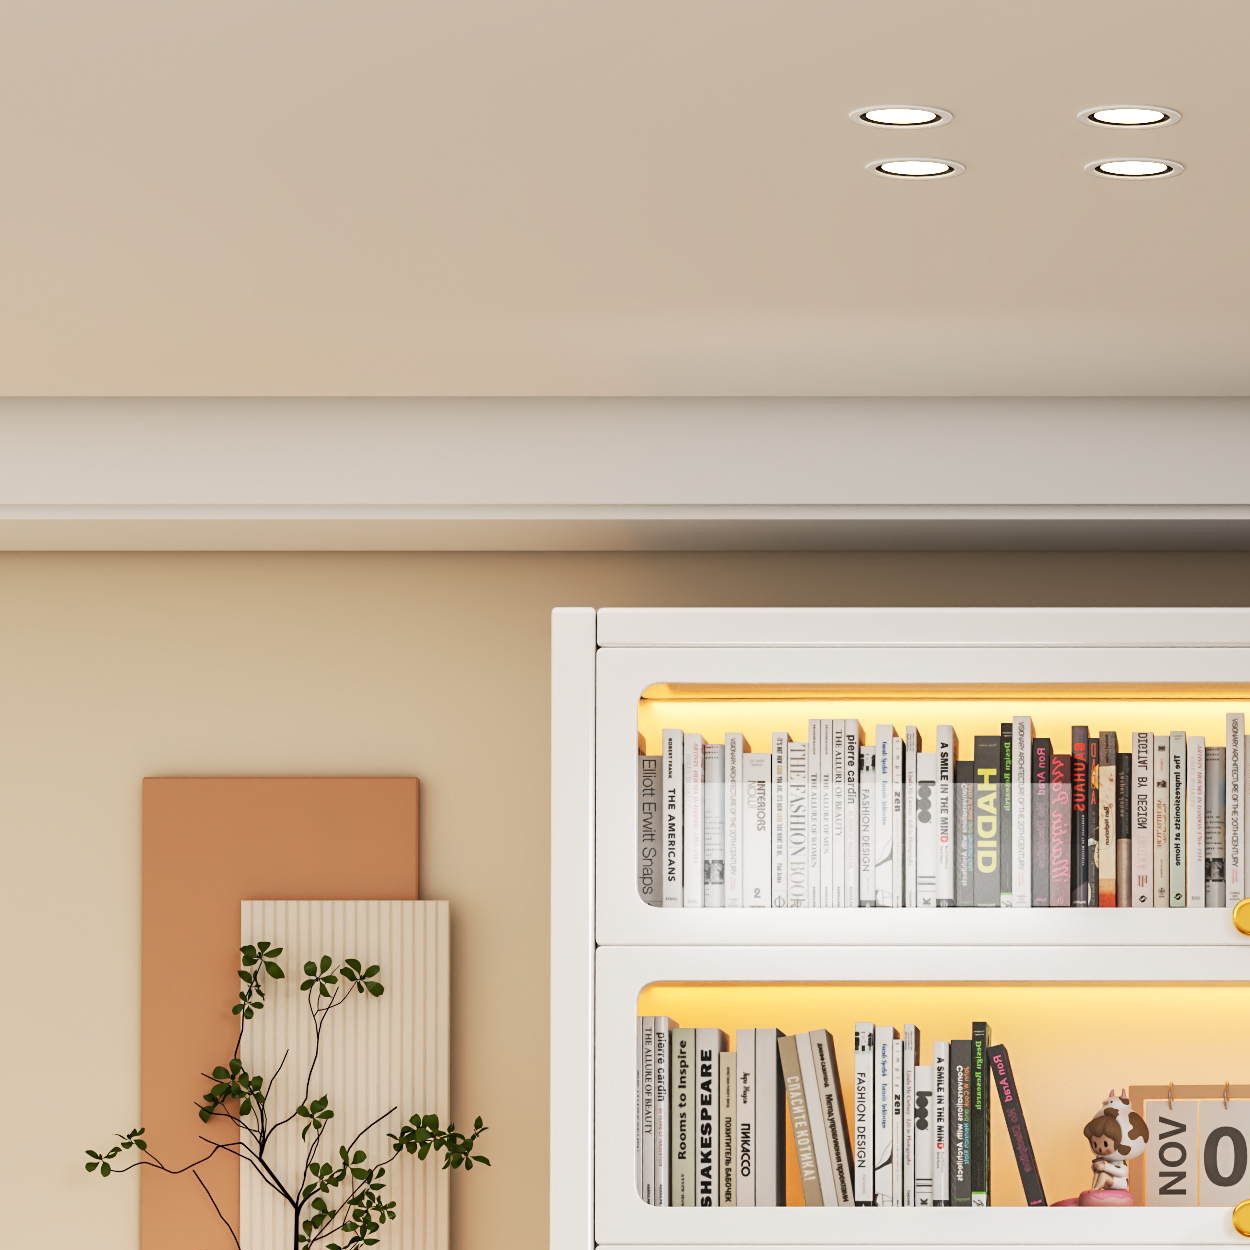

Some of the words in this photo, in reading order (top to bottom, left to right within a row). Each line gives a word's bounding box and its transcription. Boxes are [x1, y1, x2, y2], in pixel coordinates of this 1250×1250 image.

[642, 759, 657, 797] Elliott
[668, 788, 676, 810] THE
[642, 802, 657, 843] Erwitt
[640, 847, 657, 895] Snaps
[668, 814, 676, 882] AMERICANS
[678, 1040, 689, 1089] Inspire
[678, 1094, 687, 1108] to
[857, 1072, 866, 1122] FASHION
[678, 1112, 687, 1160] Rooms
[700, 1049, 712, 1207] SHAKESPEARE
[741, 1123, 751, 1177] ПИКАССО
[787, 1075, 807, 1127] СПАСИТЕ
[797, 1129, 816, 1181] КОТИКА!
[825, 1093, 835, 1119] Метод
[836, 1161, 849, 1203] проектами
[857, 1126, 866, 1169] DESIGN
[1158, 1116, 1187, 1195] NOV
